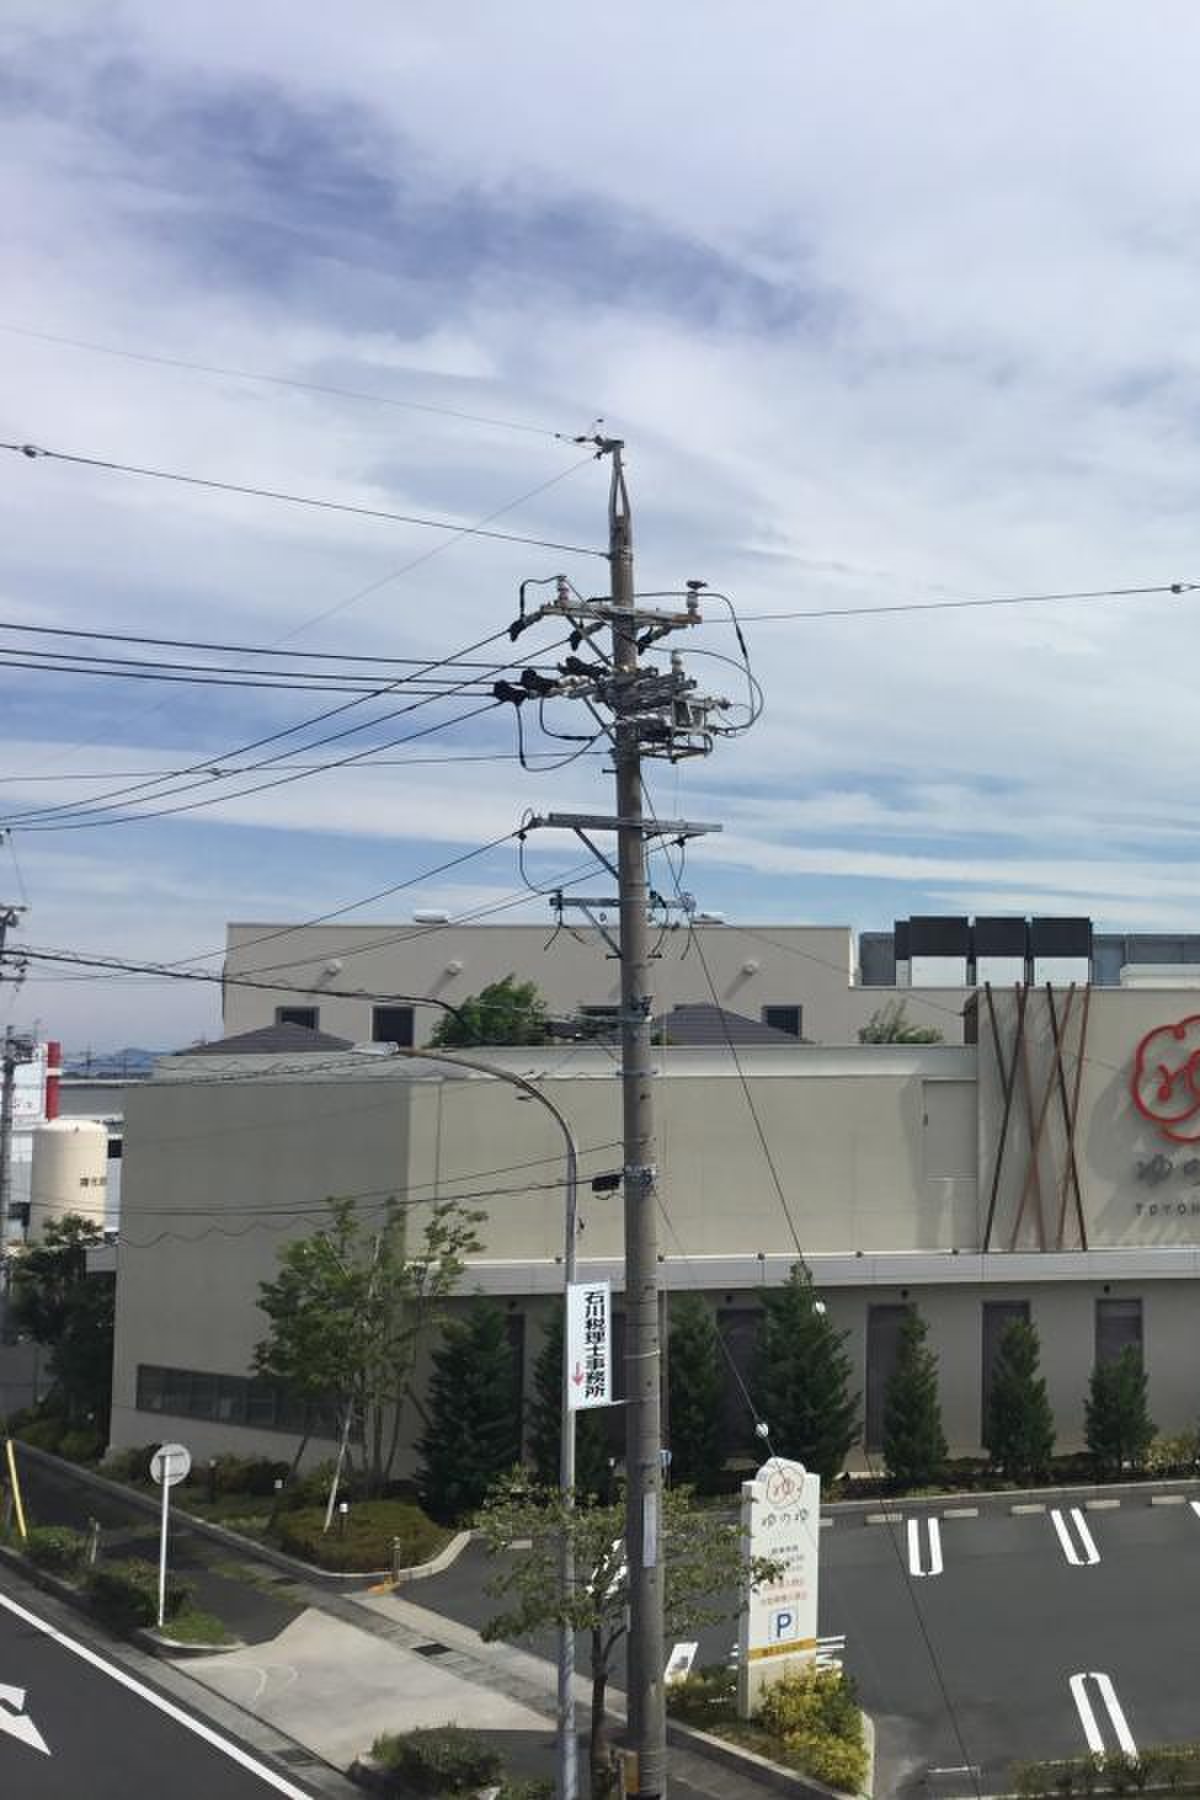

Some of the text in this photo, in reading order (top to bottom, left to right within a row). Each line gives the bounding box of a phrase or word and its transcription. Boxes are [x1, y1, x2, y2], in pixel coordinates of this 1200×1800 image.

[584, 1289, 605, 1399] 石川税理士事務所
[776, 1613, 792, 1638] P
